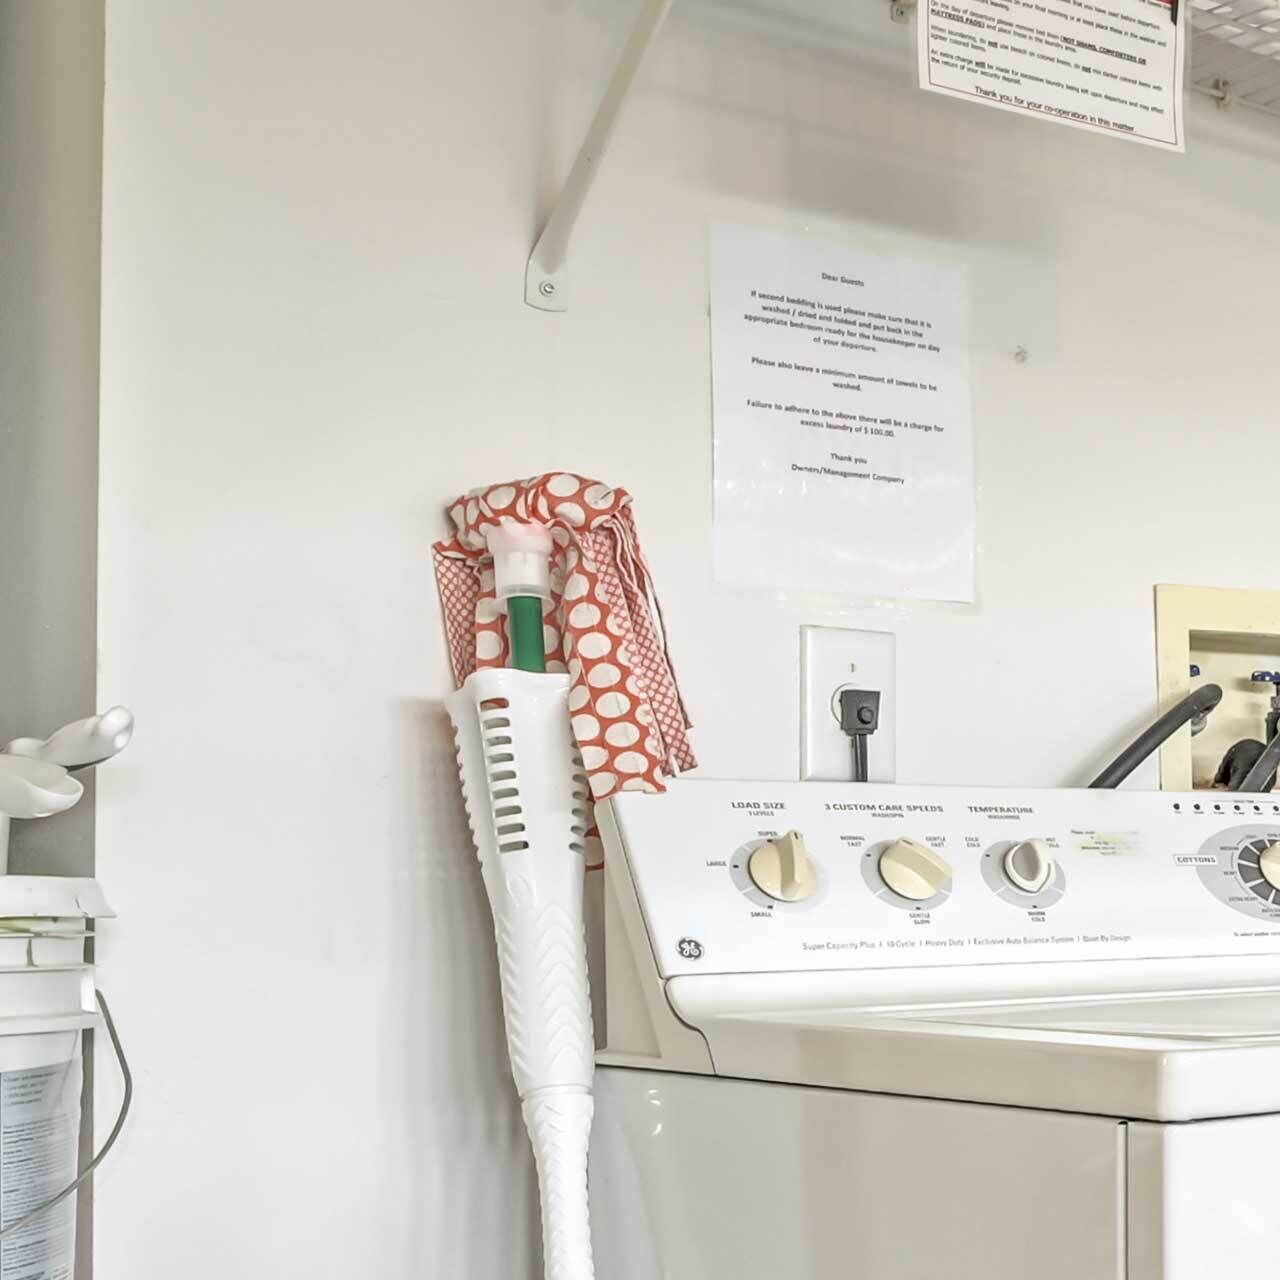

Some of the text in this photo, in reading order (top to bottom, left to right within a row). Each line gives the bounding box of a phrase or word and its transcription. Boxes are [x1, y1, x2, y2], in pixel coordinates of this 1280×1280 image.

[974, 86, 997, 98] Thank
[999, 93, 1013, 102] you
[1014, 96, 1025, 104] for
[1026, 101, 1042, 110] your
[1098, 115, 1110, 127] this
[821, 272, 864, 287] Dear Guests
[758, 293, 785, 302] second
[786, 296, 816, 309] bedding
[824, 304, 842, 312] used
[843, 307, 866, 317] please
[867, 312, 887, 321] make
[888, 315, 902, 323] sure
[904, 318, 918, 326] that
[762, 305, 790, 315] washed
[798, 310, 817, 319] dried
[819, 314, 832, 322] and
[834, 316, 857, 326] folded
[859, 321, 871, 329] and
[887, 325, 902, 334] back
[911, 330, 923, 338] the
[744, 314, 787, 327] appropriate
[790, 320, 823, 331] bedroom
[825, 328, 845, 337] ready
[859, 332, 870, 340] the
[872, 335, 916, 348] housekeeper
[928, 344, 940, 353] day
[752, 356, 775, 366] Please
[794, 363, 813, 372] leave
[822, 369, 856, 378] minimum
[858, 374, 885, 383] amount
[896, 380, 918, 388] towels
[747, 399, 772, 409] Failure
[784, 405, 810, 414] adhere
[835, 411, 857, 420] above
[859, 415, 877, 423] there
[893, 419, 902, 427] be
[909, 422, 932, 432] charge
[934, 424, 944, 432] for
[800, 420, 824, 428] excess
[826, 422, 853, 433] laundry
[830, 452, 852, 462] Thank
[791, 463, 905, 485] Owners/Management Company
[763, 802, 786, 810] SIZE
[832, 803, 877, 811] CUSTOM
[878, 804, 904, 812] CARE
[968, 806, 1033, 814] TEMPERATURE
[1177, 856, 1216, 864] COTTONS
[802, 942, 825, 951] Super
[826, 941, 859, 950] Capacity
[860, 941, 875, 949] Plus
[896, 940, 915, 948] Cycle
[925, 939, 947, 947] Heavy
[948, 938, 964, 947] Duty
[973, 937, 1003, 945] Exclusive
[1006, 937, 1022, 945] Auto
